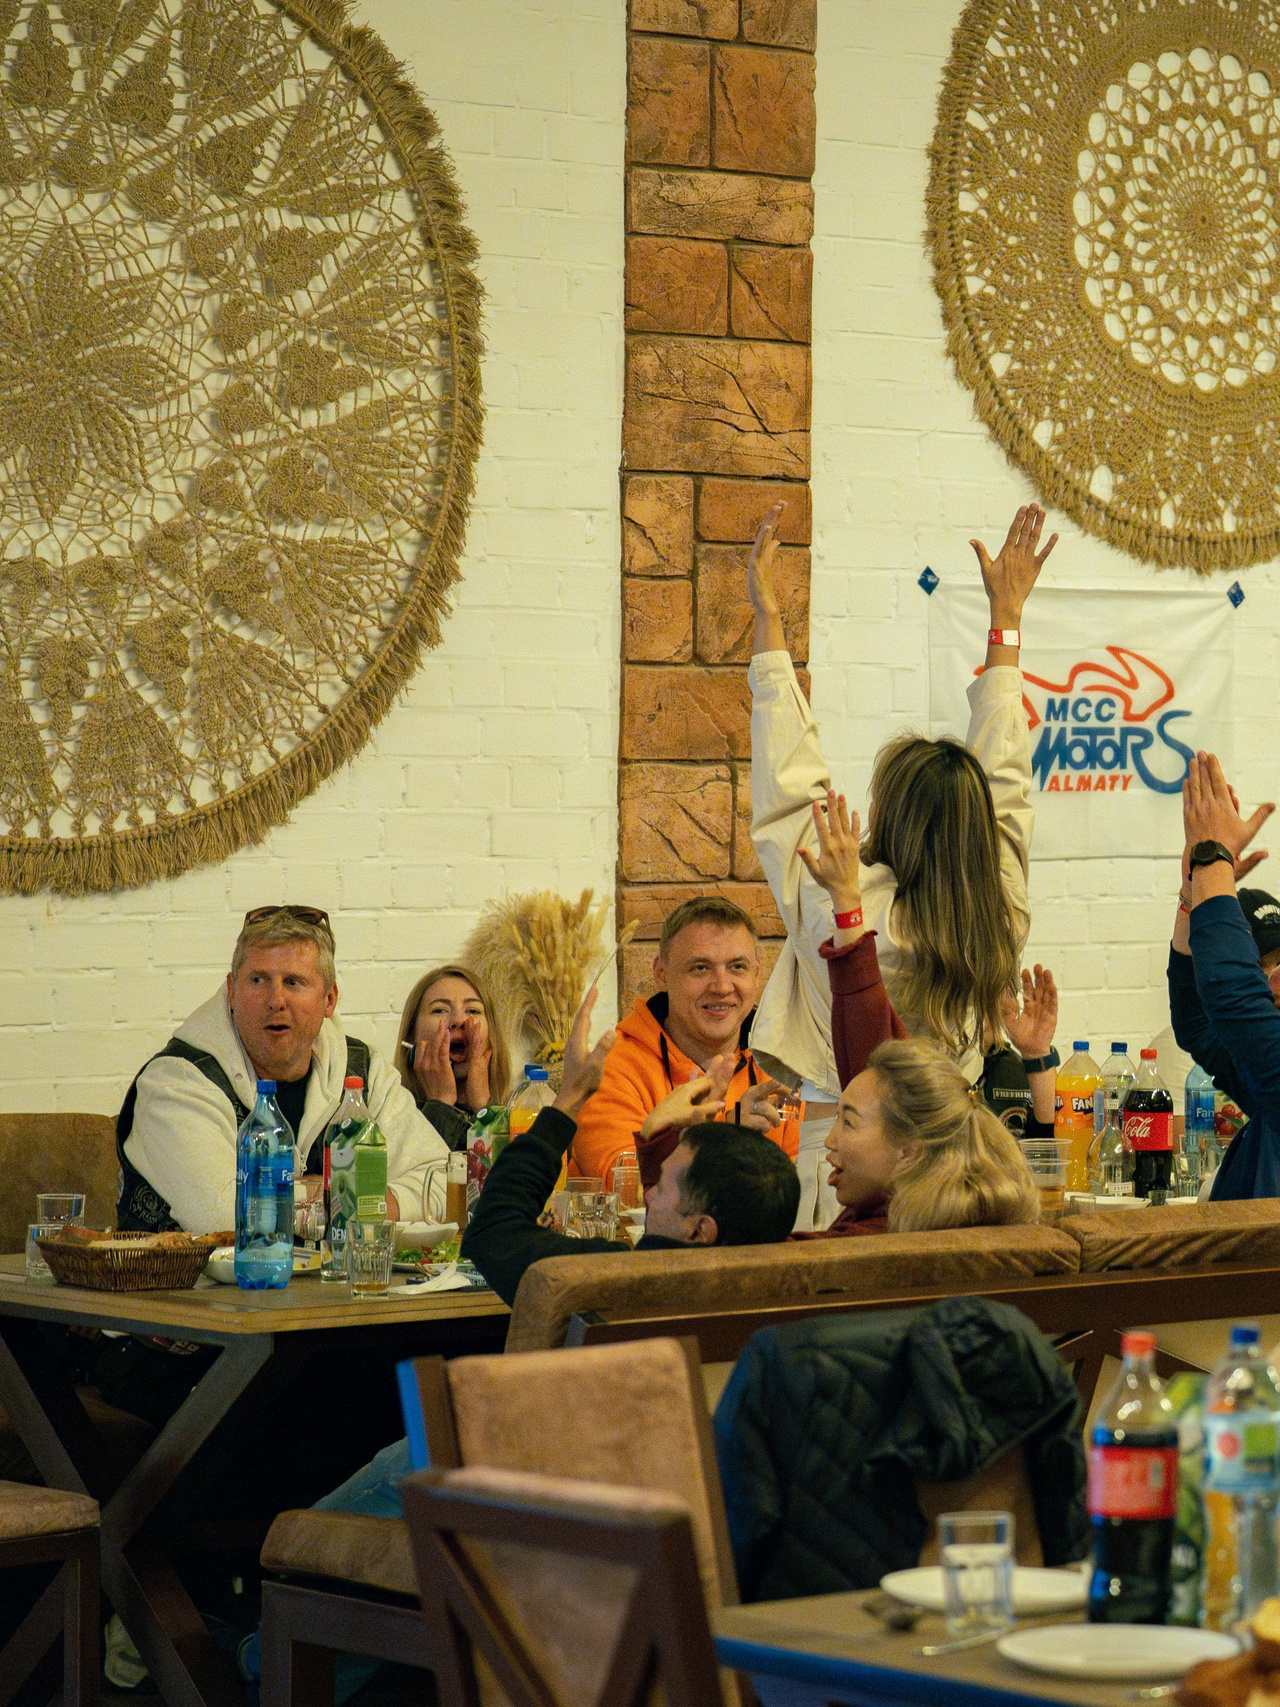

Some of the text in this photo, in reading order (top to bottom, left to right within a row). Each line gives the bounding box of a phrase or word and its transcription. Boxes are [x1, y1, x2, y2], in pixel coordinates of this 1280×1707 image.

[1045, 698, 1116, 722] MCC
[1047, 774, 1133, 792] ALMATY
[1072, 1096, 1094, 1111] FAN
[331, 1226, 347, 1241] DEN
